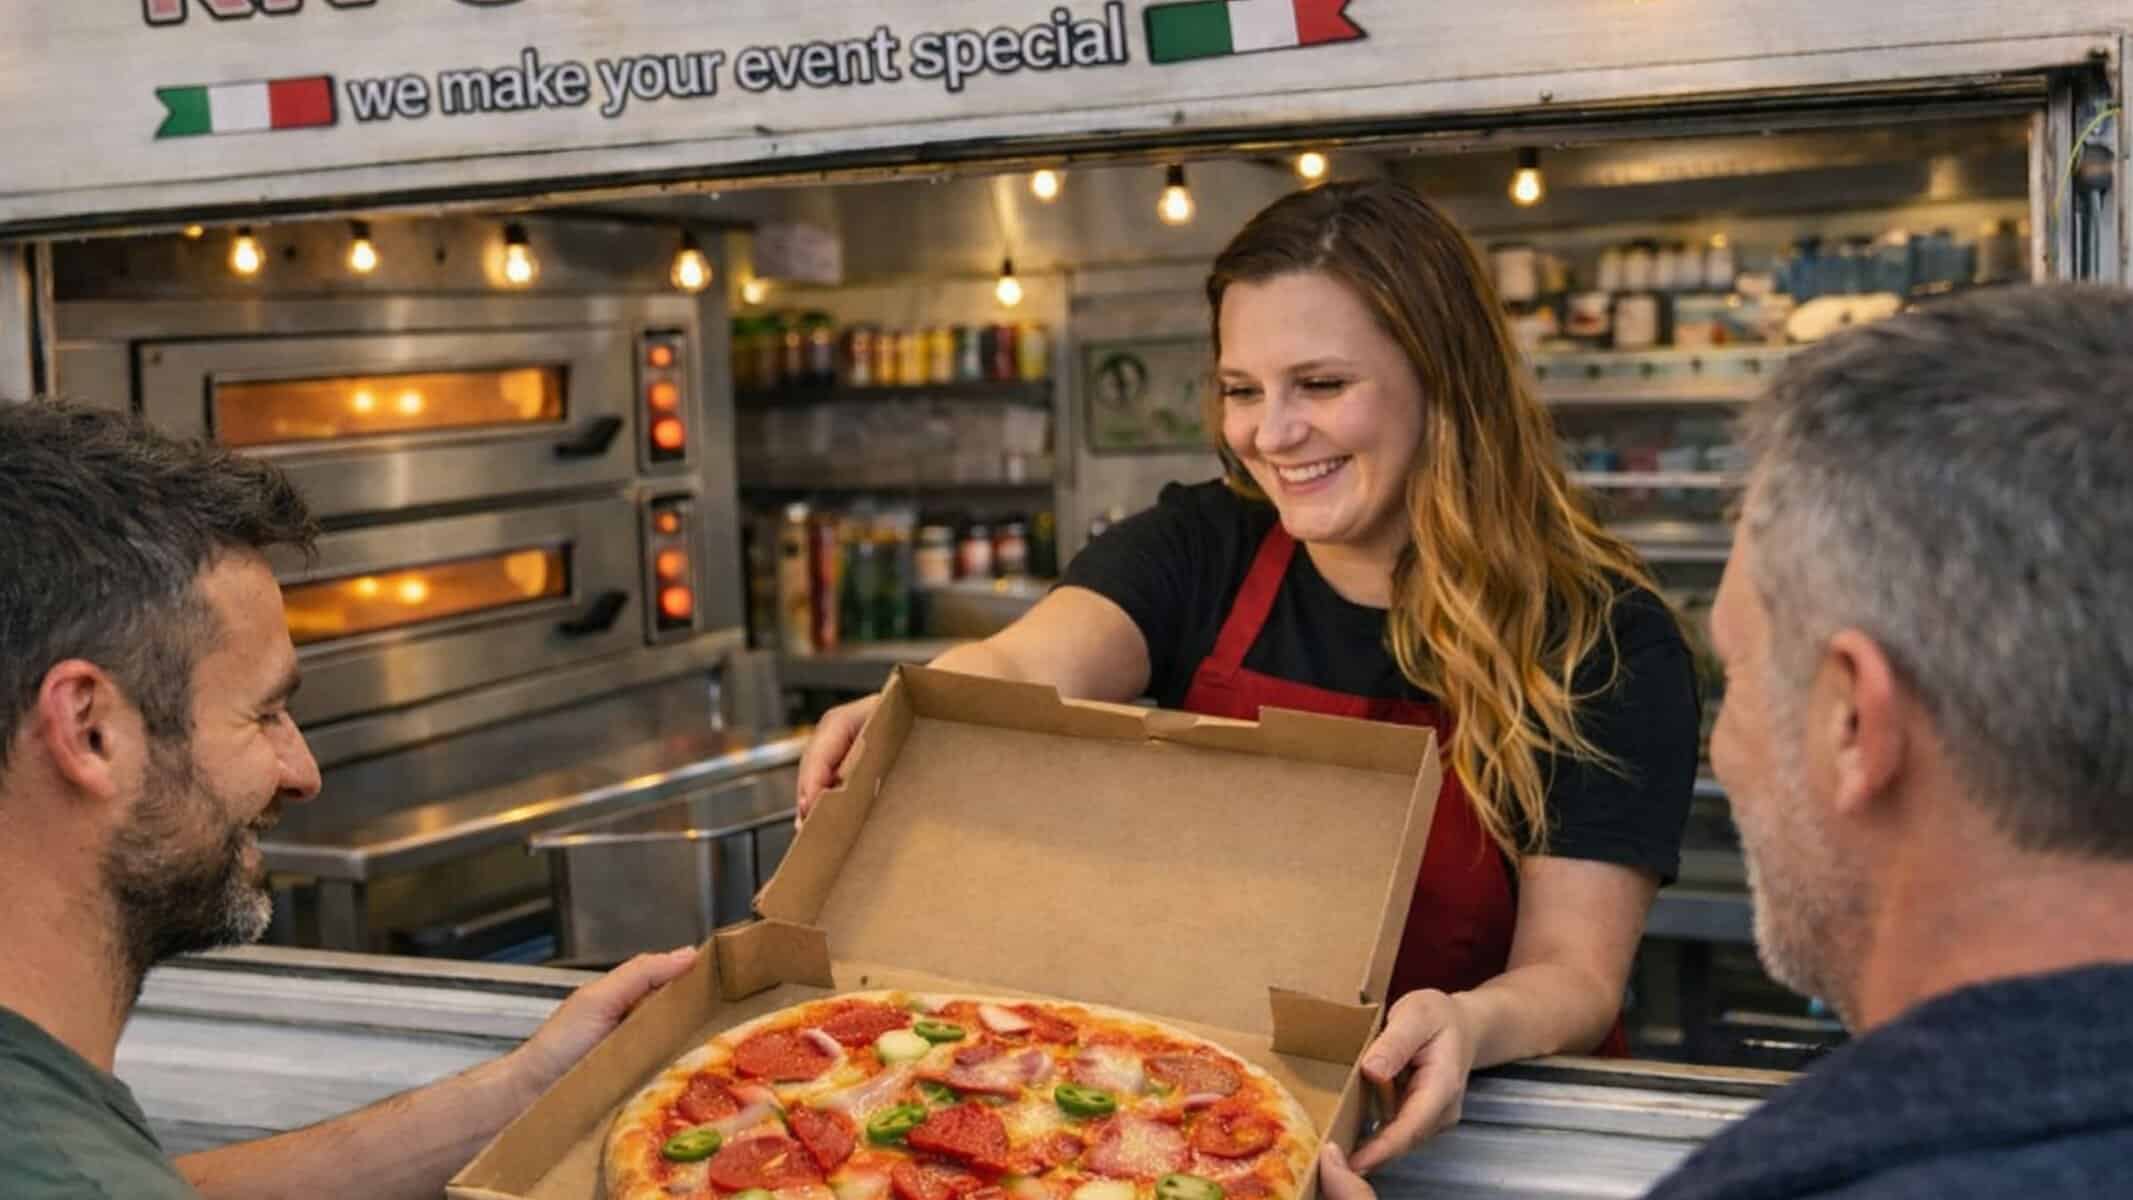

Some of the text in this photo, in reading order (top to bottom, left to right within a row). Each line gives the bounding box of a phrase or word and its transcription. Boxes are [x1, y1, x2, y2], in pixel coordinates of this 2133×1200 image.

[348, 1, 1129, 121] we make your event special
